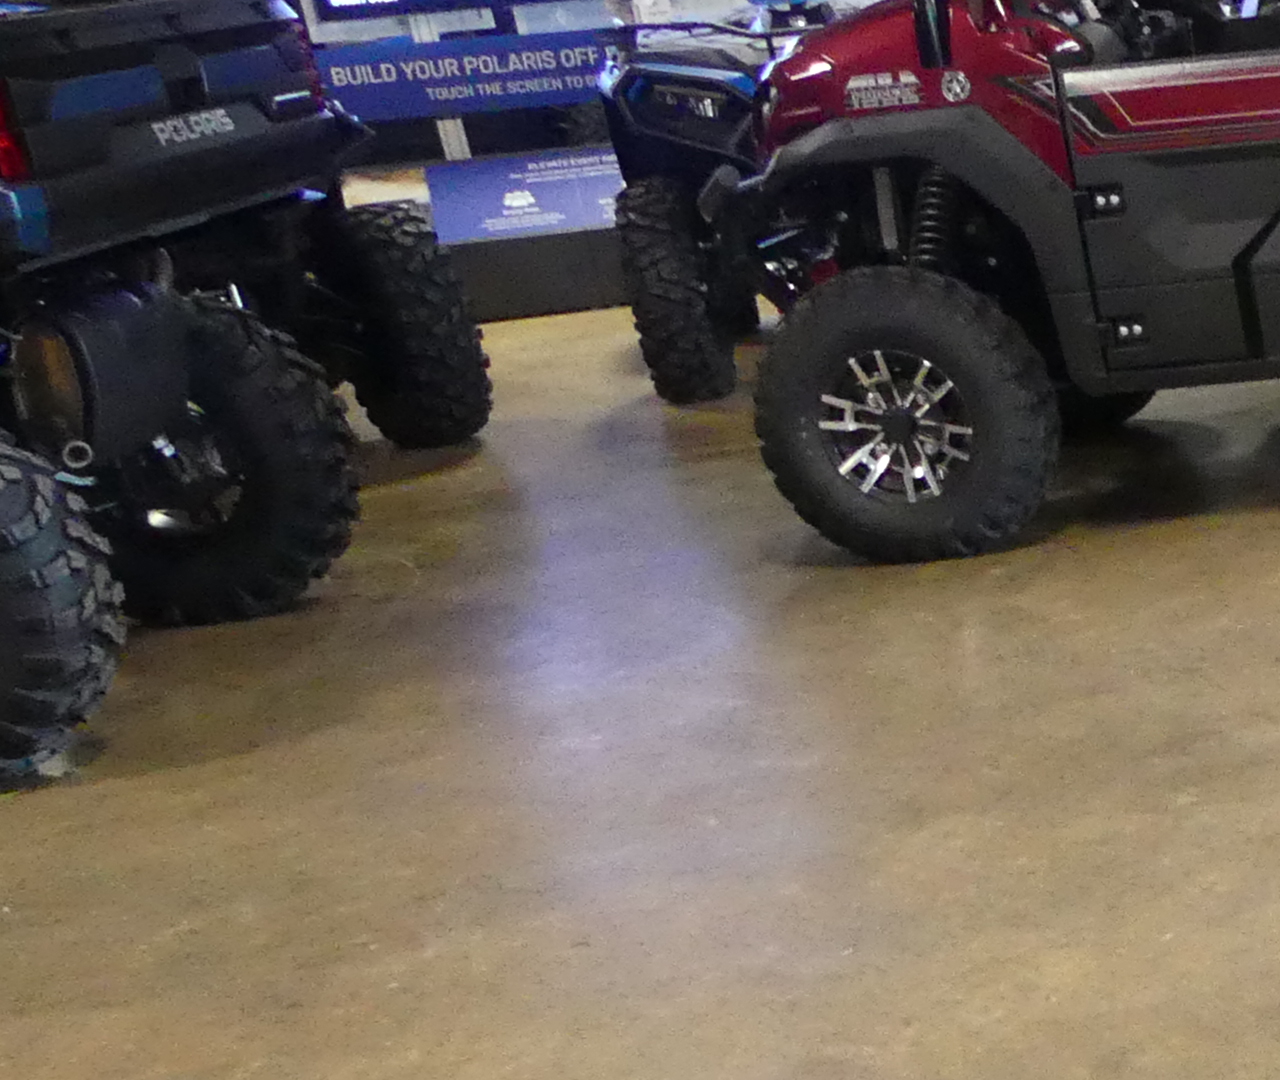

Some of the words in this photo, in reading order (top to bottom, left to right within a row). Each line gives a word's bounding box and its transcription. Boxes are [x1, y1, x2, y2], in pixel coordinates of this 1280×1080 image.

[330, 62, 397, 87] BUILD
[400, 58, 460, 81] YOUR
[465, 50, 557, 77] POLARIS
[560, 46, 598, 69] OFF
[426, 84, 474, 100] TOUCH
[476, 81, 504, 97] THE
[507, 77, 563, 95] SCREEN
[565, 74, 584, 90] TO
[150, 108, 235, 147] POLARIS
